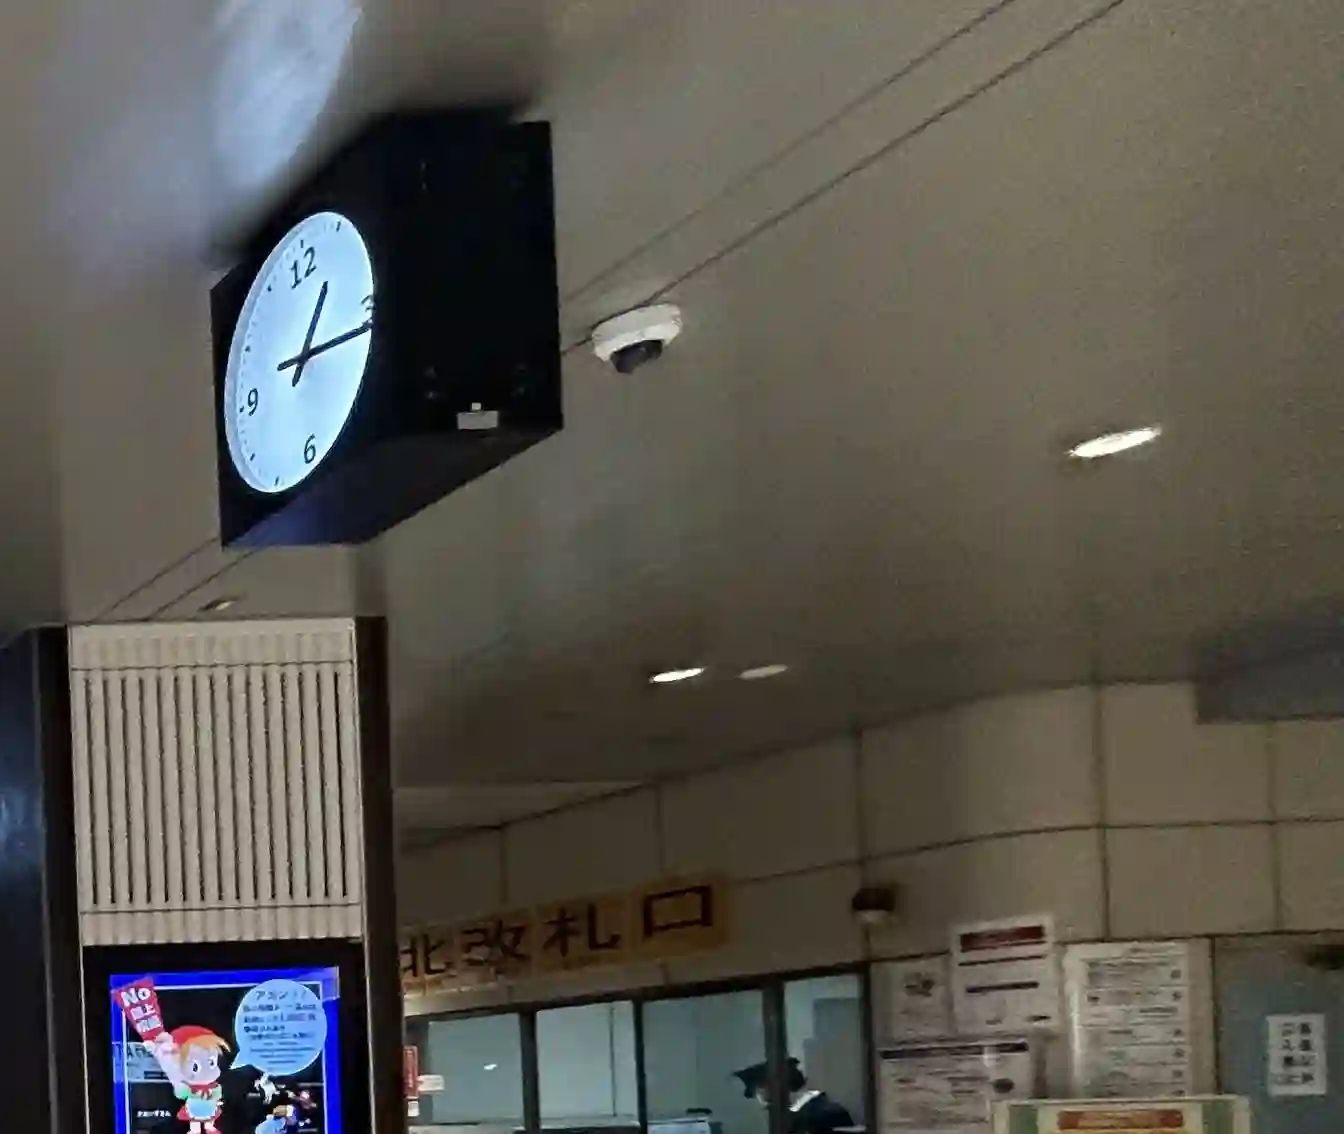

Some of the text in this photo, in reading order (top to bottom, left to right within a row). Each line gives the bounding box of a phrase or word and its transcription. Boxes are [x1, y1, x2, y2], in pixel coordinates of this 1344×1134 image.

[291, 247, 316, 289] 12
[247, 388, 259, 416] 9
[304, 435, 316, 464] 6
[398, 885, 712, 976] 北改札口
[120, 987, 151, 1007] No
